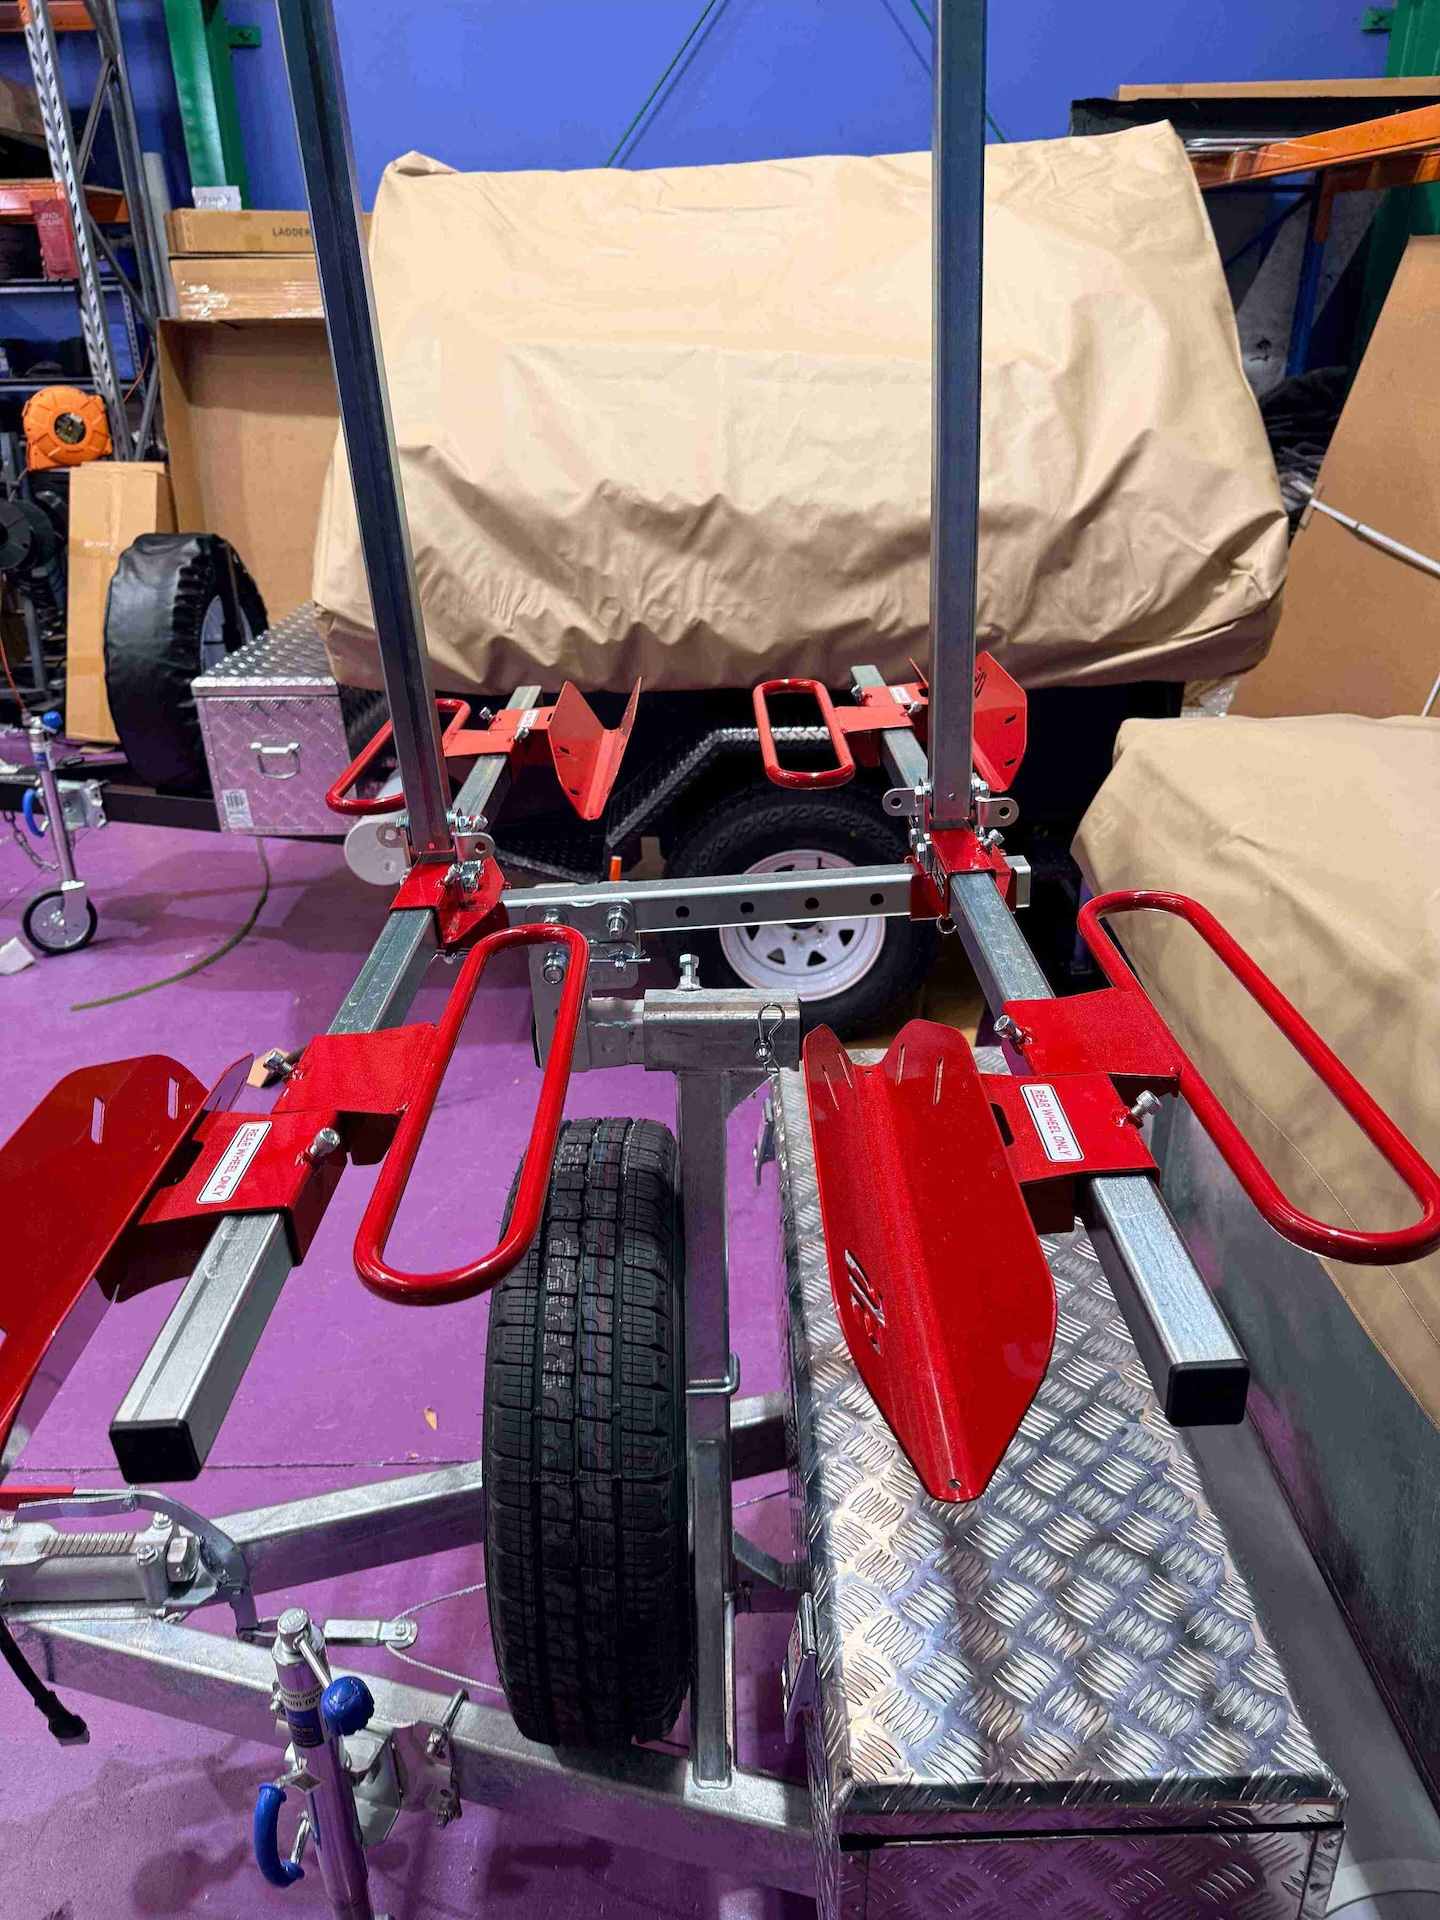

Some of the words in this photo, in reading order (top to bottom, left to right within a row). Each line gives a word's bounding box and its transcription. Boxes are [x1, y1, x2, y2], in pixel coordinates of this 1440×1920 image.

[1031, 1089, 1051, 1108] REAR
[1042, 1109, 1061, 1134] WHEEL
[1054, 1136, 1073, 1156] ONLY
[239, 1128, 259, 1147] REAR
[212, 1176, 231, 1196] ONLY
